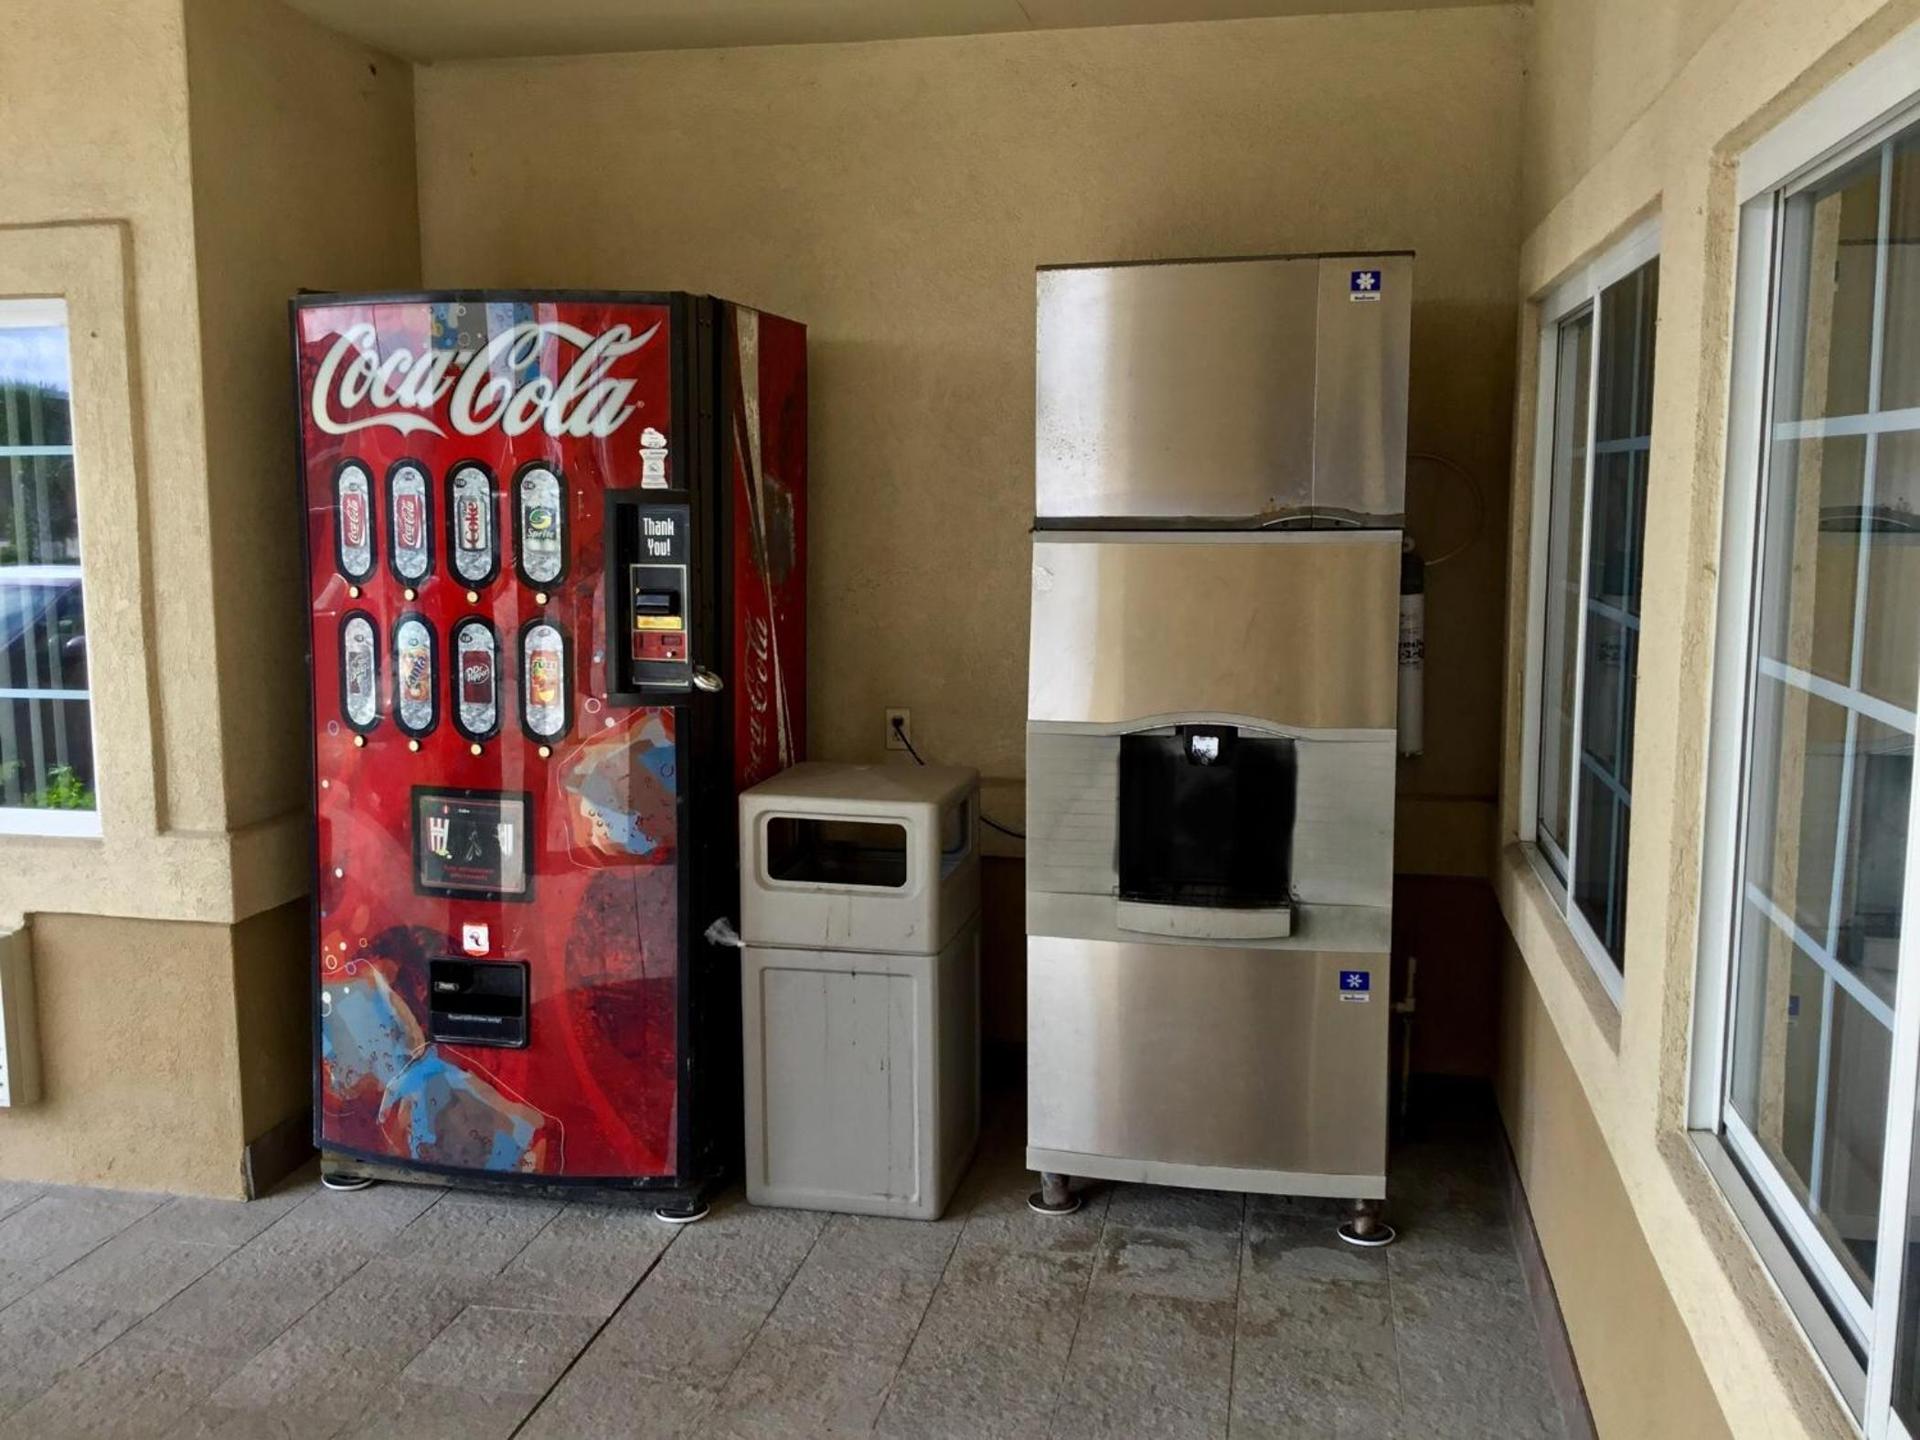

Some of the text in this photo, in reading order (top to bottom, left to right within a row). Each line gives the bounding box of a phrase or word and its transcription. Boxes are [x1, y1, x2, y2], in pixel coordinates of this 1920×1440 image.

[465, 502, 479, 547] Coke
[643, 518, 675, 536] Thank
[647, 538, 671, 556] You!
